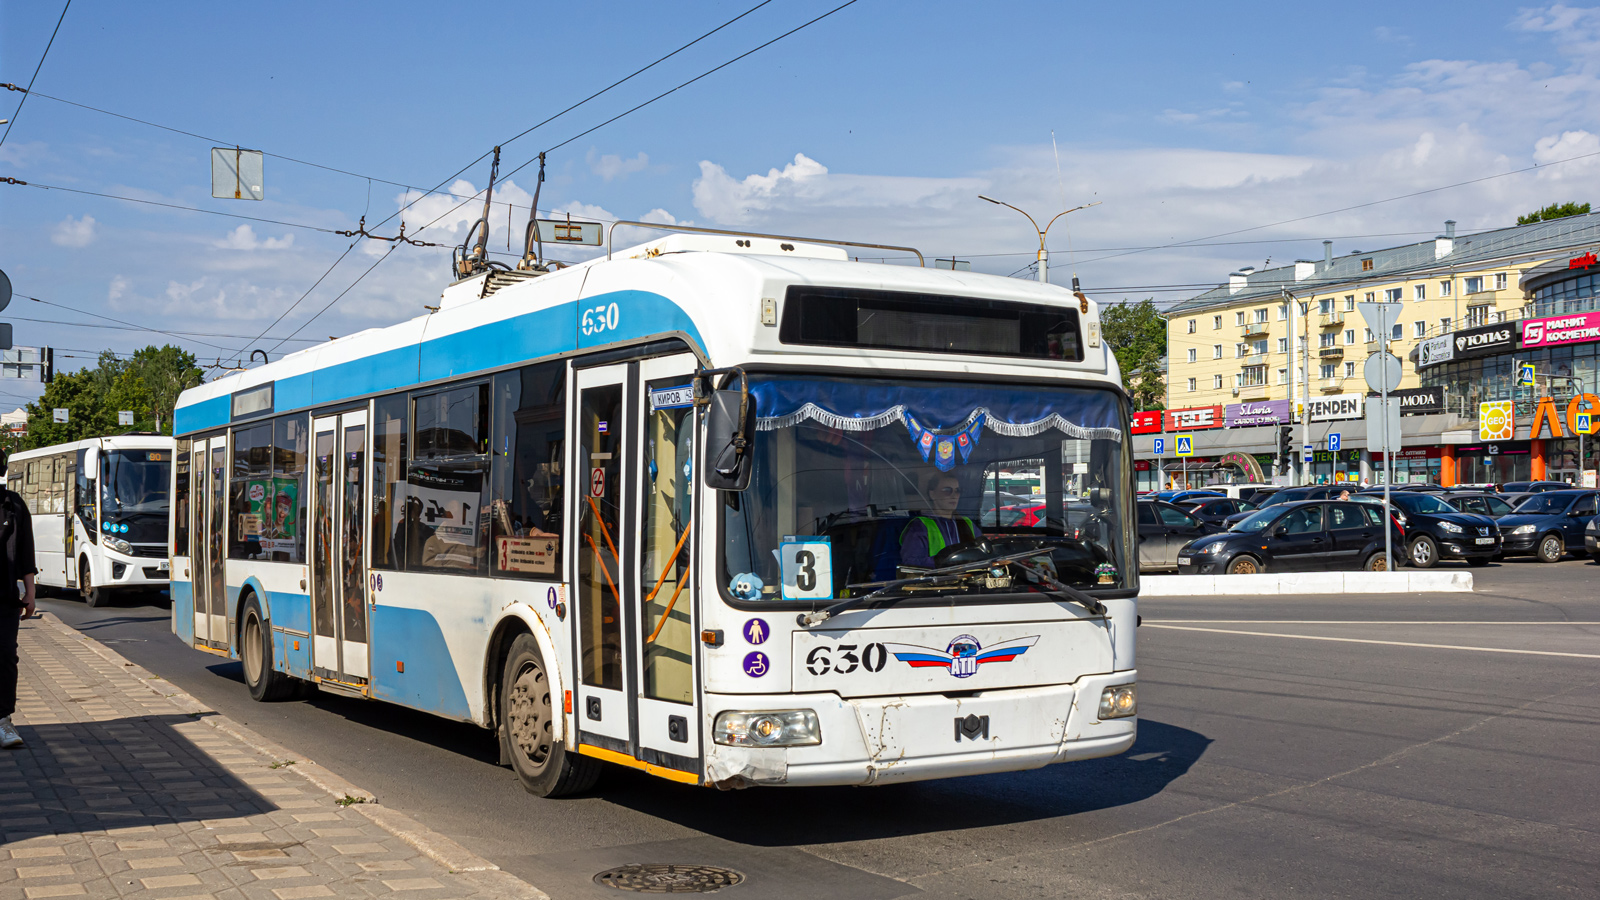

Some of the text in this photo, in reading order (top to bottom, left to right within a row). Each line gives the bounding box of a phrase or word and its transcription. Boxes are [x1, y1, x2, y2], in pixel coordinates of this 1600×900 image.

[1546, 317, 1586, 330] МАГНИТ
[1467, 330, 1510, 346] ТОПАЗ
[1546, 327, 1600, 342] КОСМЕТИК
[657, 389, 693, 405] КИРОВ 43
[1309, 399, 1357, 416] ZENDEN
[1487, 416, 1505, 425] GEO
[1350, 451, 1360, 460] 24
[796, 550, 816, 591] 3
[806, 642, 887, 676] 630
[951, 656, 977, 675] АТП
